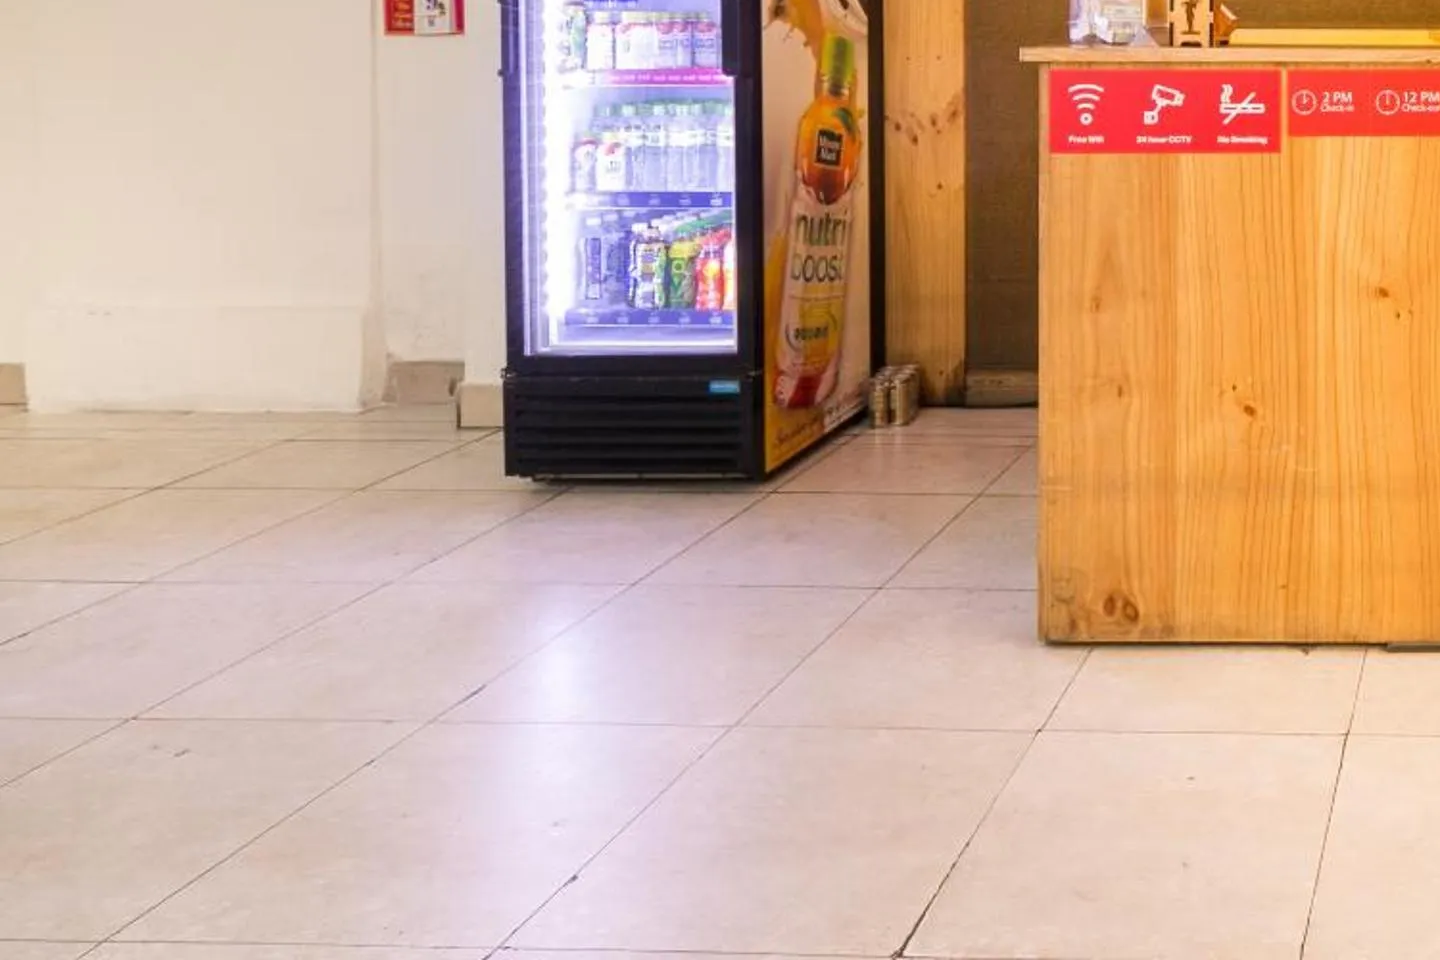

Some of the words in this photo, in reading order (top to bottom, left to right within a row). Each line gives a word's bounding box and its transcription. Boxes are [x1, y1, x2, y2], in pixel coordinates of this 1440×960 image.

[1323, 91, 1330, 102] 2
[1333, 91, 1353, 102] PM
[1403, 91, 1417, 102] 12
[1421, 91, 1440, 102] PM
